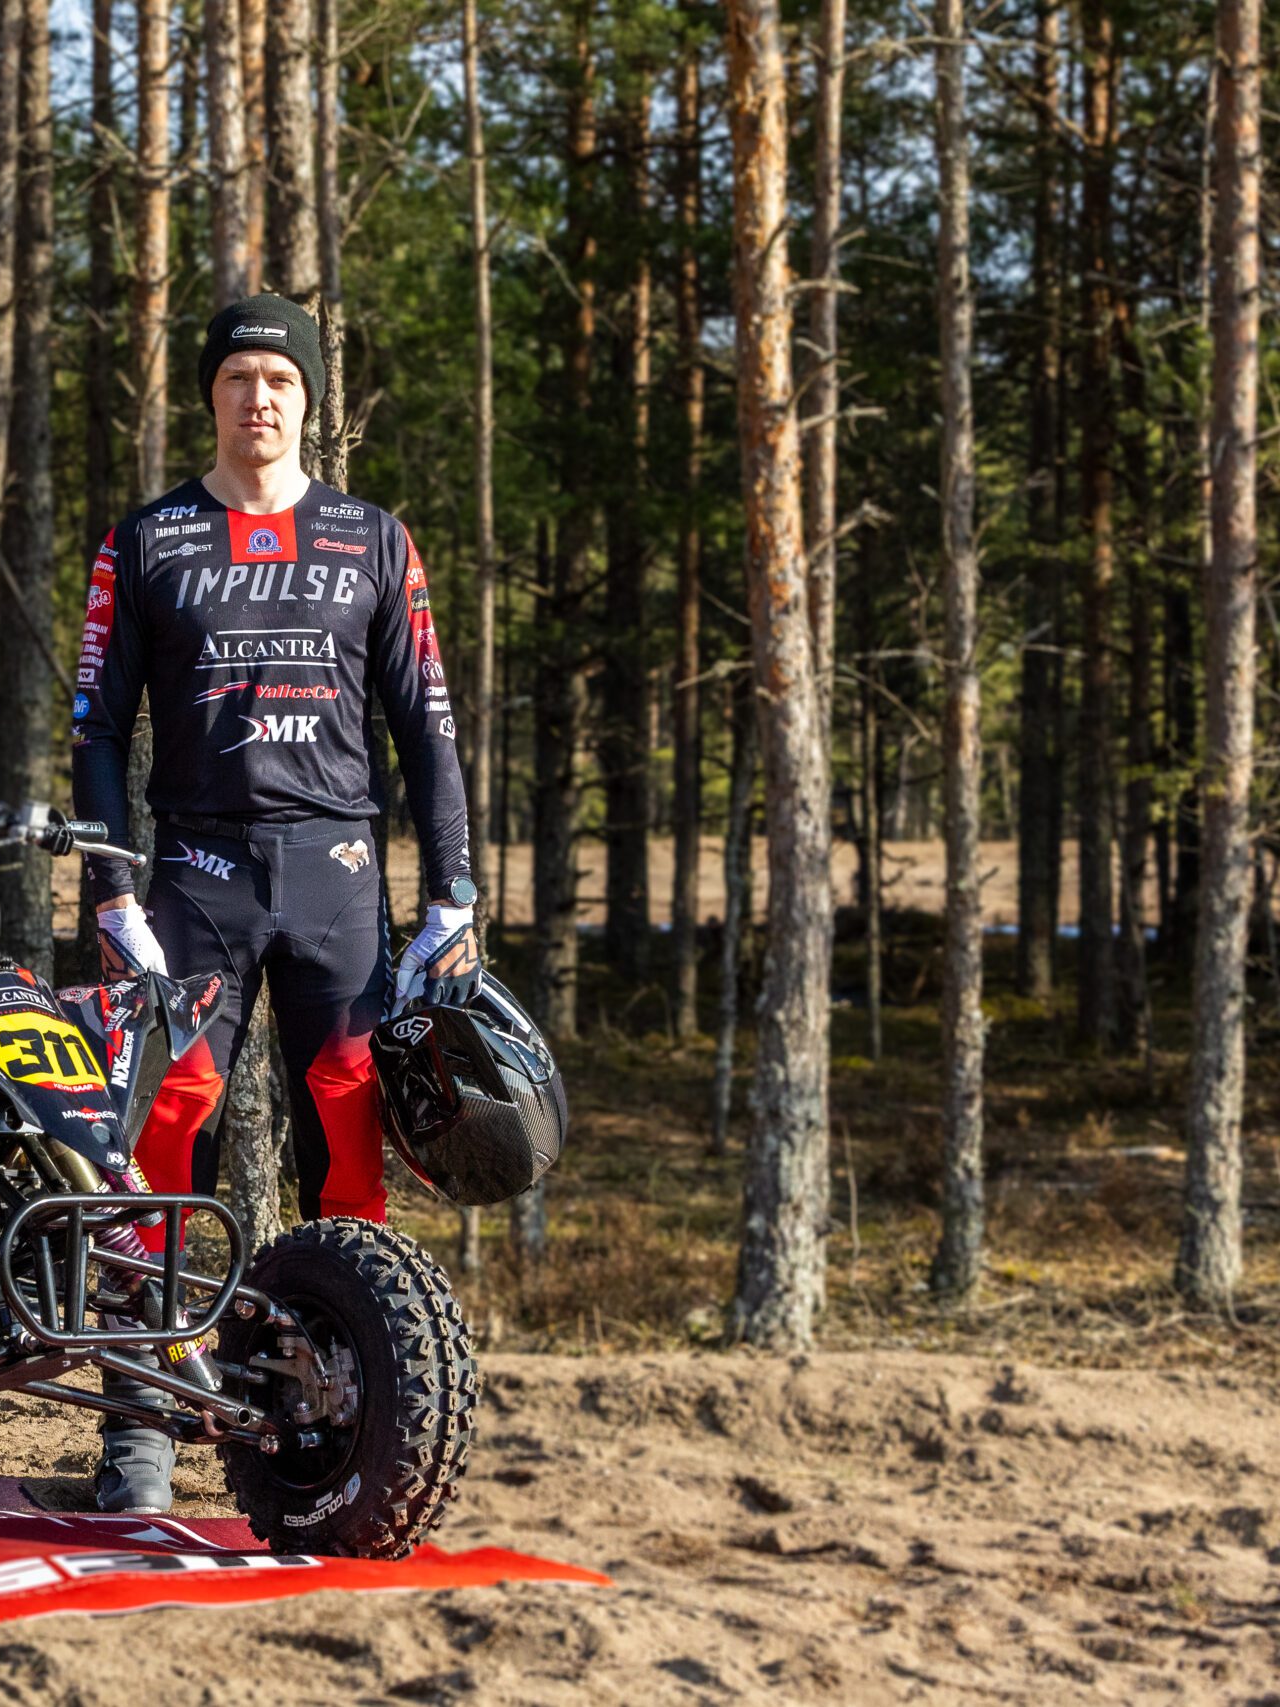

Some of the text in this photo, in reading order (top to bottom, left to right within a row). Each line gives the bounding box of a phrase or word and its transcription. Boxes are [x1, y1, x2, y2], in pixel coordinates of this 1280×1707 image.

[155, 505, 198, 521] FIM
[320, 505, 364, 517] BECKERI
[155, 522, 211, 538] TARMO TOMSON
[176, 564, 359, 609] IMPULSE
[198, 631, 338, 660] ALCANTRA
[261, 714, 320, 742] MK
[194, 849, 236, 881] MK
[73, 1083, 94, 1092] SAAR
[283, 1492, 344, 1527] GOLDSPEED
